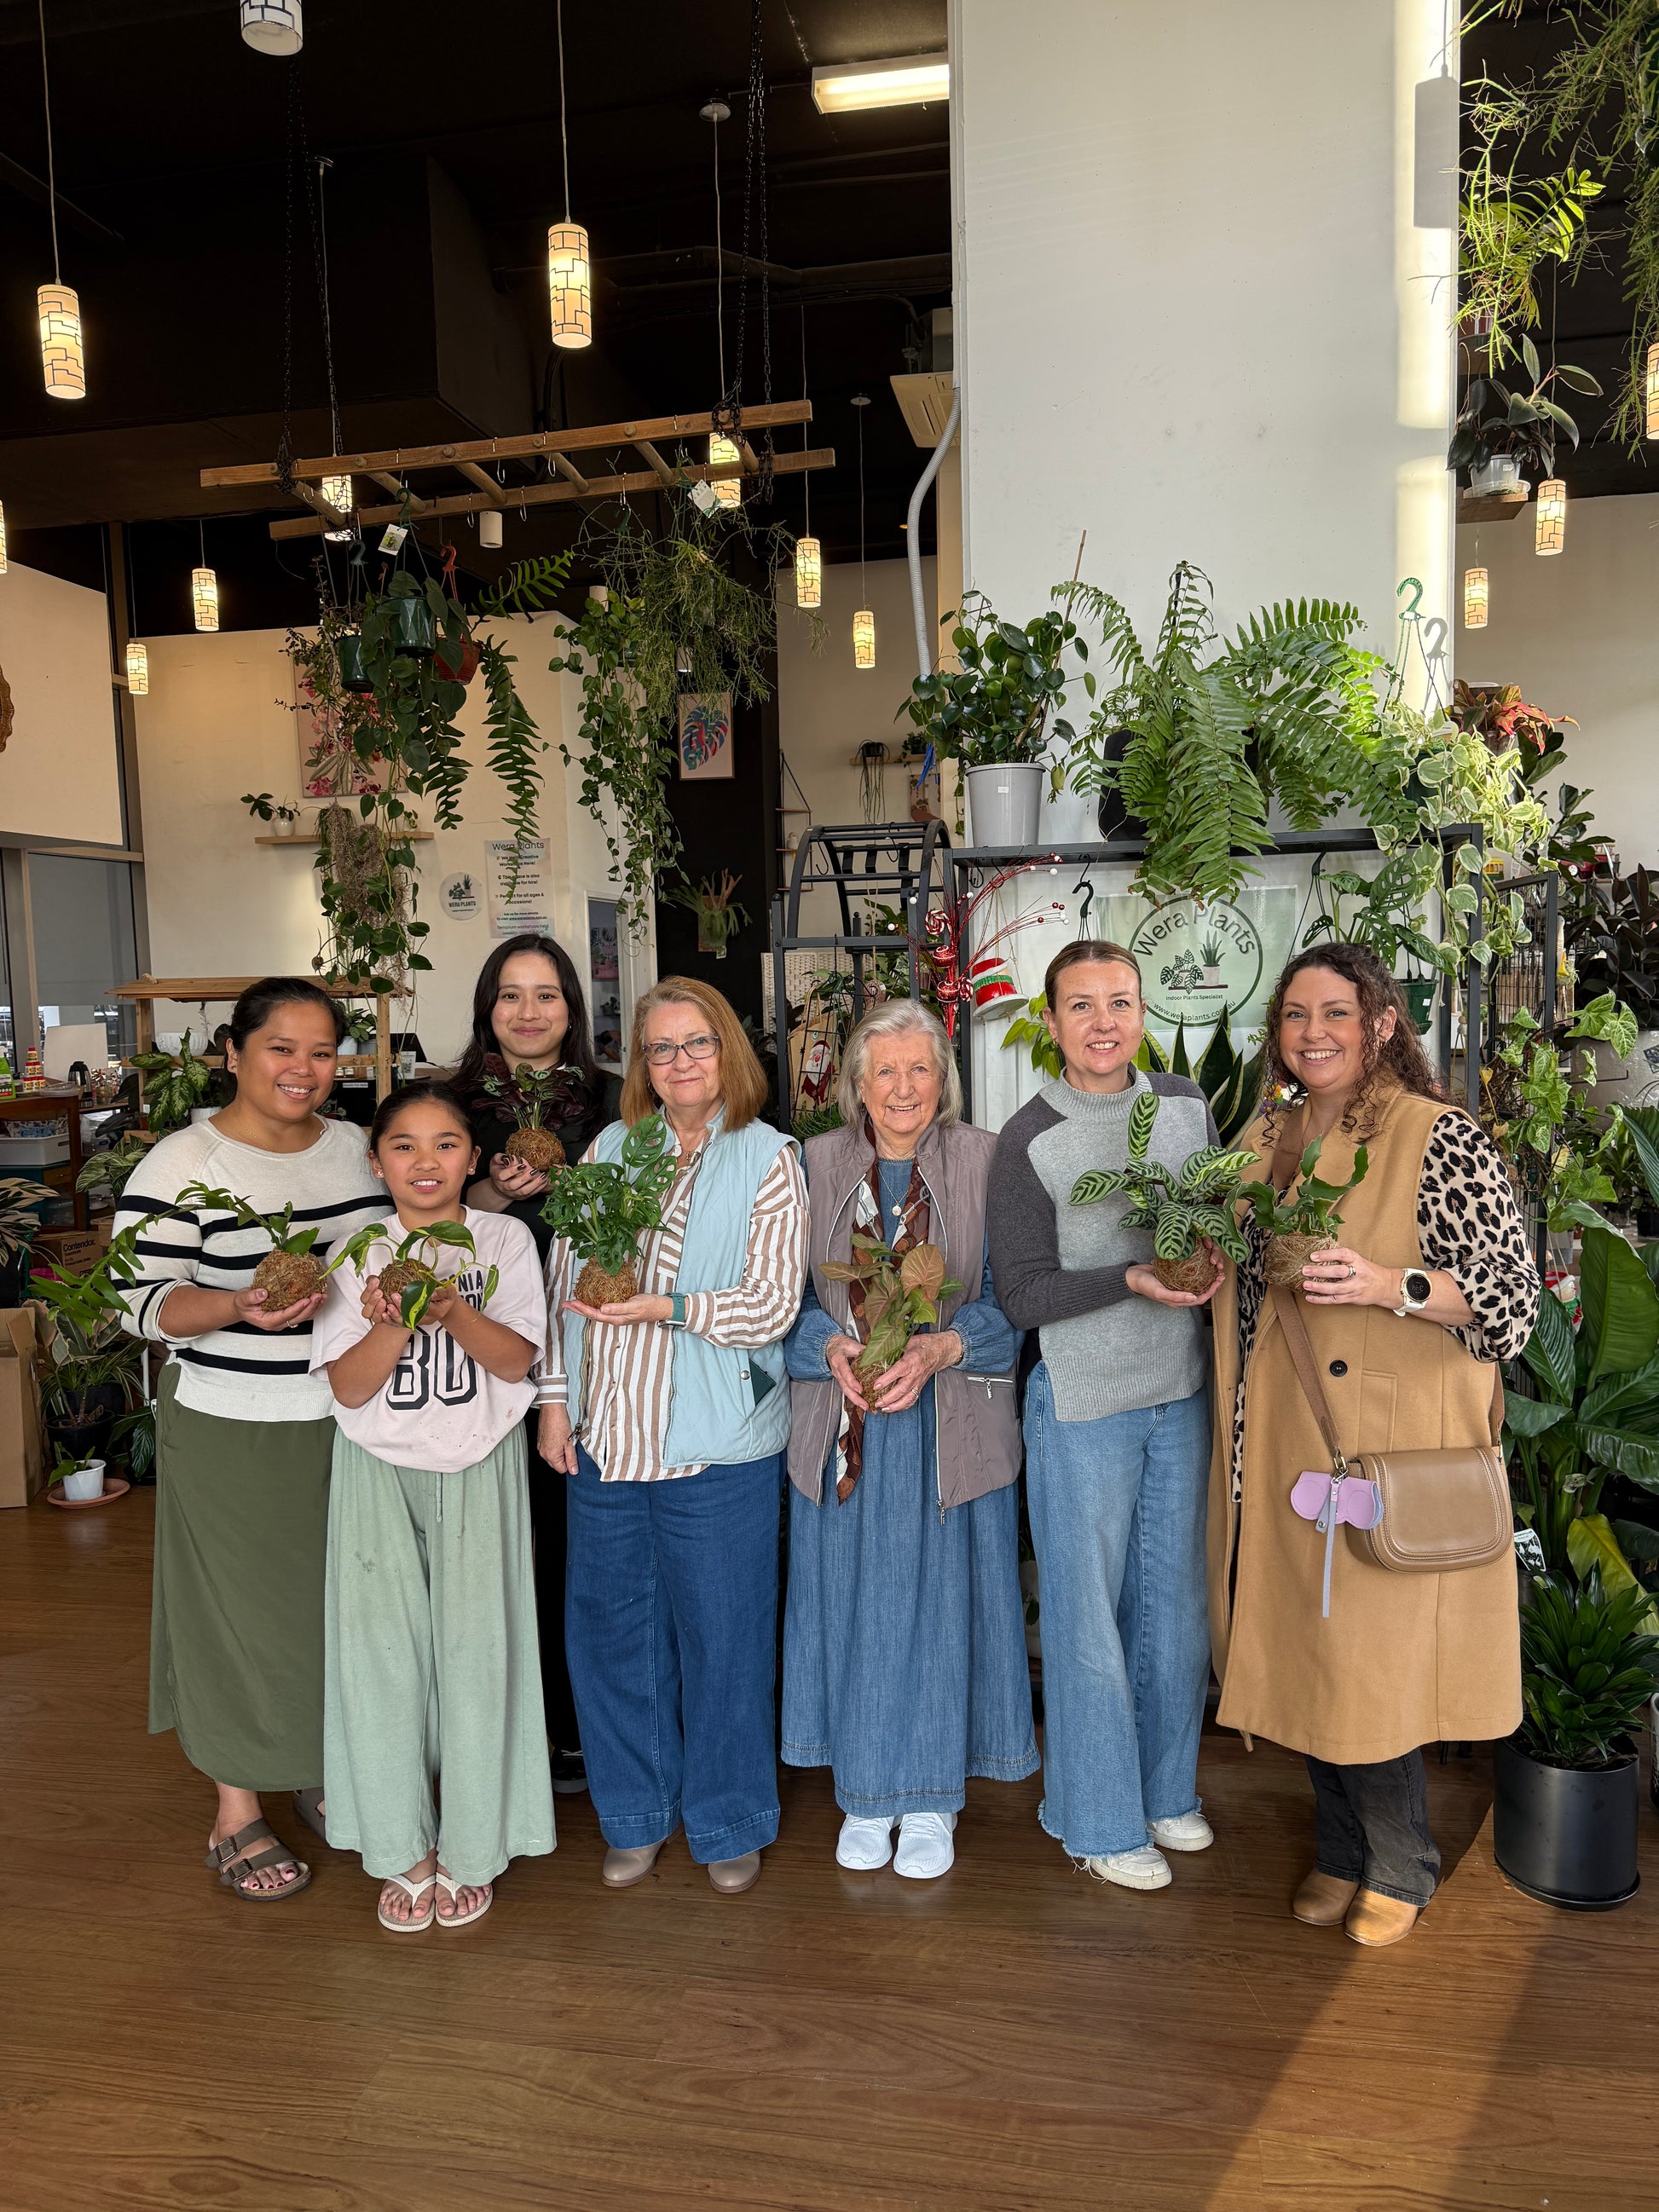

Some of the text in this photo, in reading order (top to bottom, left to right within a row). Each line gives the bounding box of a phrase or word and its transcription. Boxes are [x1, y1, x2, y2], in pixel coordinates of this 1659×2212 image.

[1133, 905, 1255, 956] Wera Plants
[1153, 1001, 1236, 1022] www.weaplants.coau
